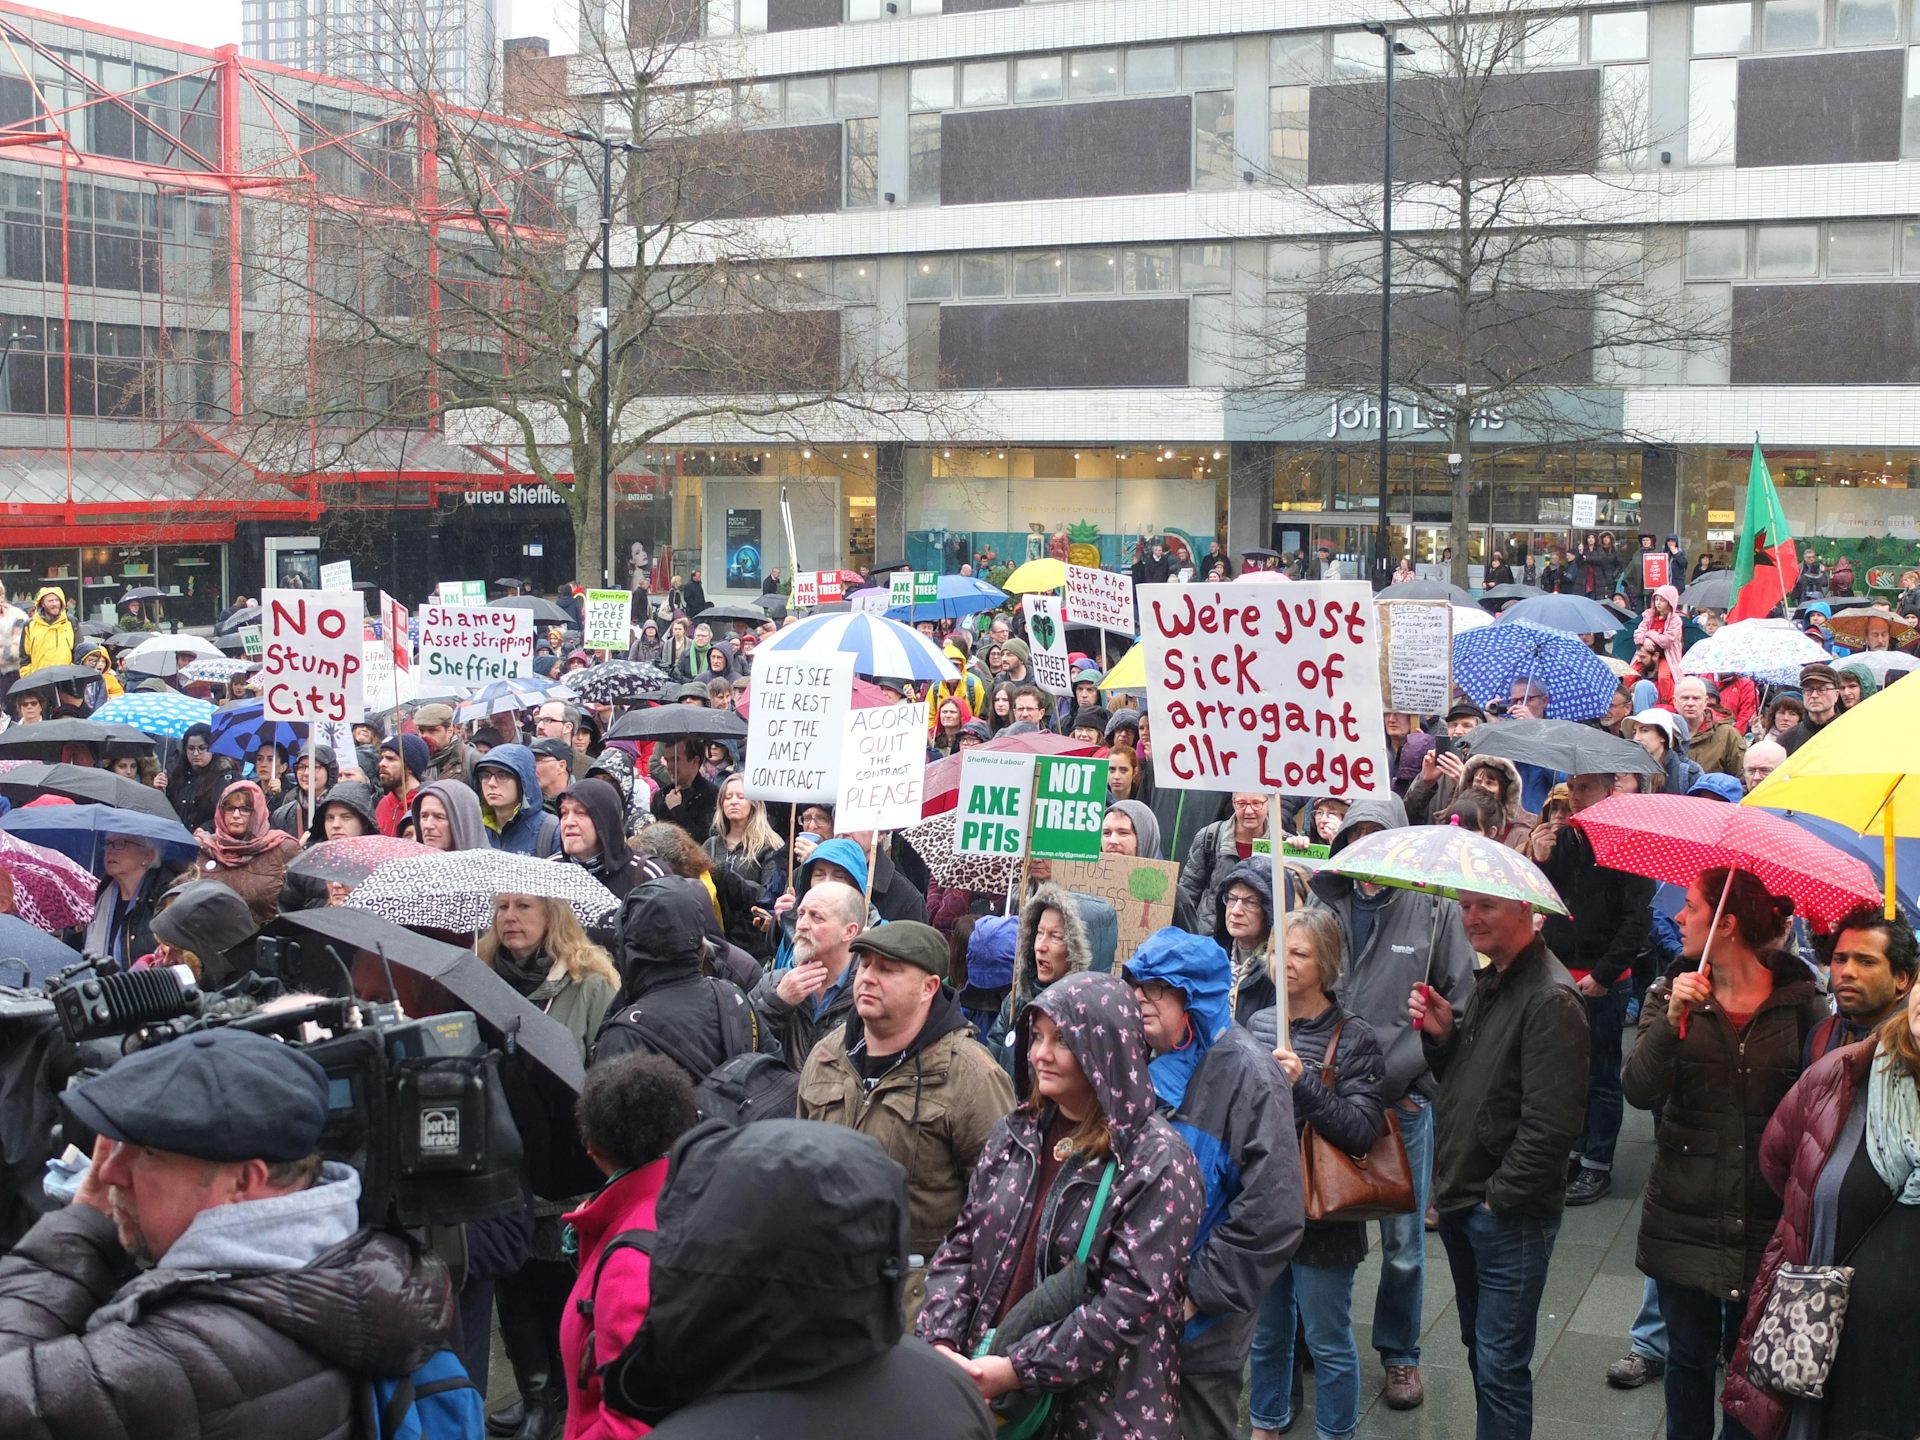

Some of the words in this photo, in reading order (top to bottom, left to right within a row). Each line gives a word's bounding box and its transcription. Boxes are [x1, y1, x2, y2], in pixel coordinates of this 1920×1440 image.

[1326, 397, 1403, 440] John
[1412, 396, 1505, 430] Leis
[464, 489, 505, 504] area
[509, 484, 576, 505] sheffie
[1849, 519, 1869, 527] TIME
[1872, 519, 1885, 527] TO
[798, 583, 814, 593] AXE
[821, 573, 837, 584] NOT
[893, 582, 911, 593] AXE
[918, 572, 934, 584] NOT
[1069, 566, 1098, 584] Stop
[1104, 574, 1125, 590] the
[444, 593, 460, 604] AXE
[615, 593, 629, 601] Party
[797, 594, 816, 605] PFIs
[819, 584, 842, 595] TREES
[892, 594, 912, 605] PFIs
[915, 583, 938, 596] TREES
[1066, 580, 1131, 607] Netheredge
[588, 610, 624, 620] Trees
[593, 602, 625, 611] Love
[1033, 599, 1048, 613] WE
[1152, 592, 1262, 639] We're
[426, 608, 516, 634] Shamey
[589, 619, 622, 629] Hate
[1073, 608, 1130, 627] massacre
[244, 635, 260, 644] AXE
[422, 629, 468, 648] Asset
[472, 631, 532, 657] Stripping
[266, 643, 360, 690] Stump
[379, 662, 397, 671] WEE
[428, 652, 519, 681] Sheffield
[1033, 653, 1067, 671] STREET
[765, 665, 805, 687] LET'S
[808, 667, 834, 687] SEE
[1036, 669, 1068, 689] TREES
[1296, 652, 1345, 699] of
[268, 683, 346, 722] City
[760, 692, 786, 711] THE
[792, 692, 832, 714] REST
[768, 719, 788, 738] OF
[793, 719, 821, 738] THE
[850, 705, 927, 733] ACORN
[1166, 700, 1361, 742] arrogant
[768, 741, 813, 762] AMEY
[859, 731, 910, 755] QUIT
[869, 754, 892, 767] THE
[967, 756, 999, 764] Sheffield
[1000, 758, 1025, 766] Labour
[1169, 733, 1238, 781] Cllr
[1257, 744, 1375, 795] Lodge
[752, 767, 828, 791] CONTRACT
[856, 762, 913, 782] CONTRACT
[1047, 761, 1097, 796] NOT
[845, 779, 921, 812] PLEASE
[967, 784, 1021, 817] AXE
[1035, 797, 1103, 833] TREES
[960, 820, 1021, 854] PFIs
[1030, 850, 1098, 859] o.stump.city@gmail.com
[1303, 849, 1325, 858] Party
[1065, 883, 1128, 912] SELESS
[424, 1133, 458, 1147] brace
